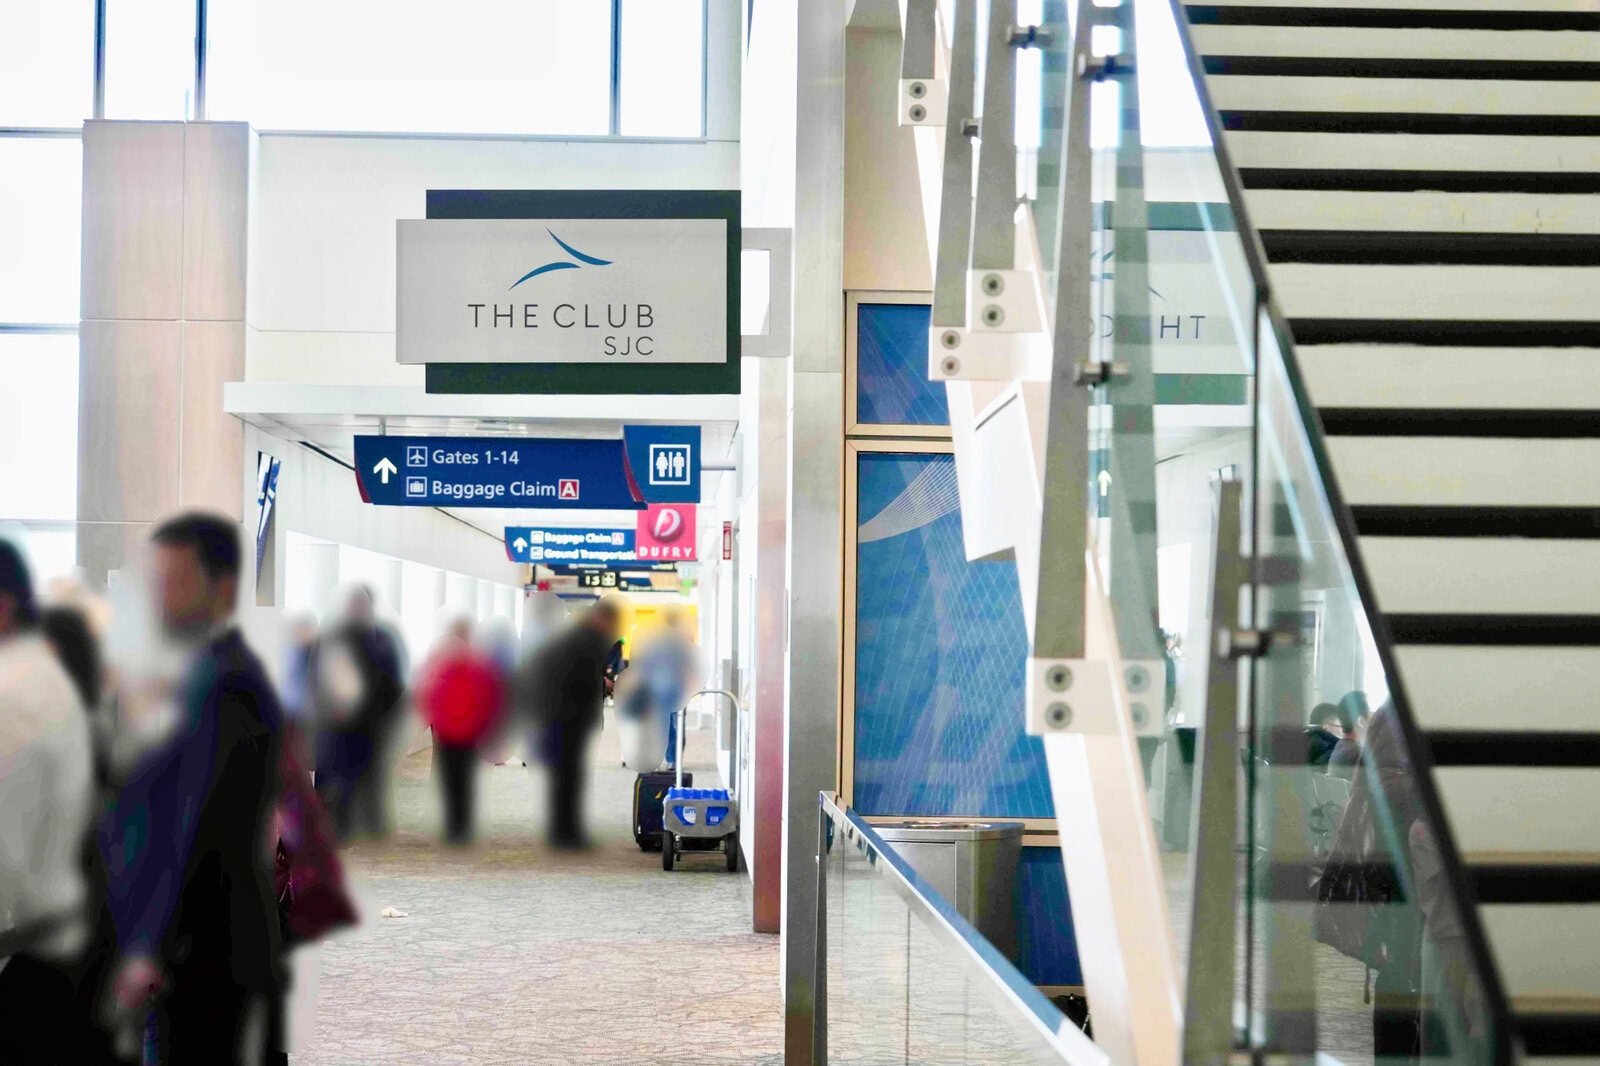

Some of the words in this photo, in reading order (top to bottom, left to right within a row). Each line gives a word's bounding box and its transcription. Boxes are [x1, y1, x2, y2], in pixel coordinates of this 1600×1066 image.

[467, 303, 539, 328] THE
[552, 303, 654, 329] CLUB
[603, 335, 654, 356] SJC
[432, 449, 479, 465] Gates
[484, 450, 520, 465] 1-14
[432, 480, 505, 499] Baggage
[509, 481, 556, 497] Claim
[561, 481, 577, 498] A
[544, 532, 585, 545] Baggage
[585, 532, 612, 544] Claim
[544, 548, 579, 559] Ground
[639, 546, 692, 558] DUFRY
